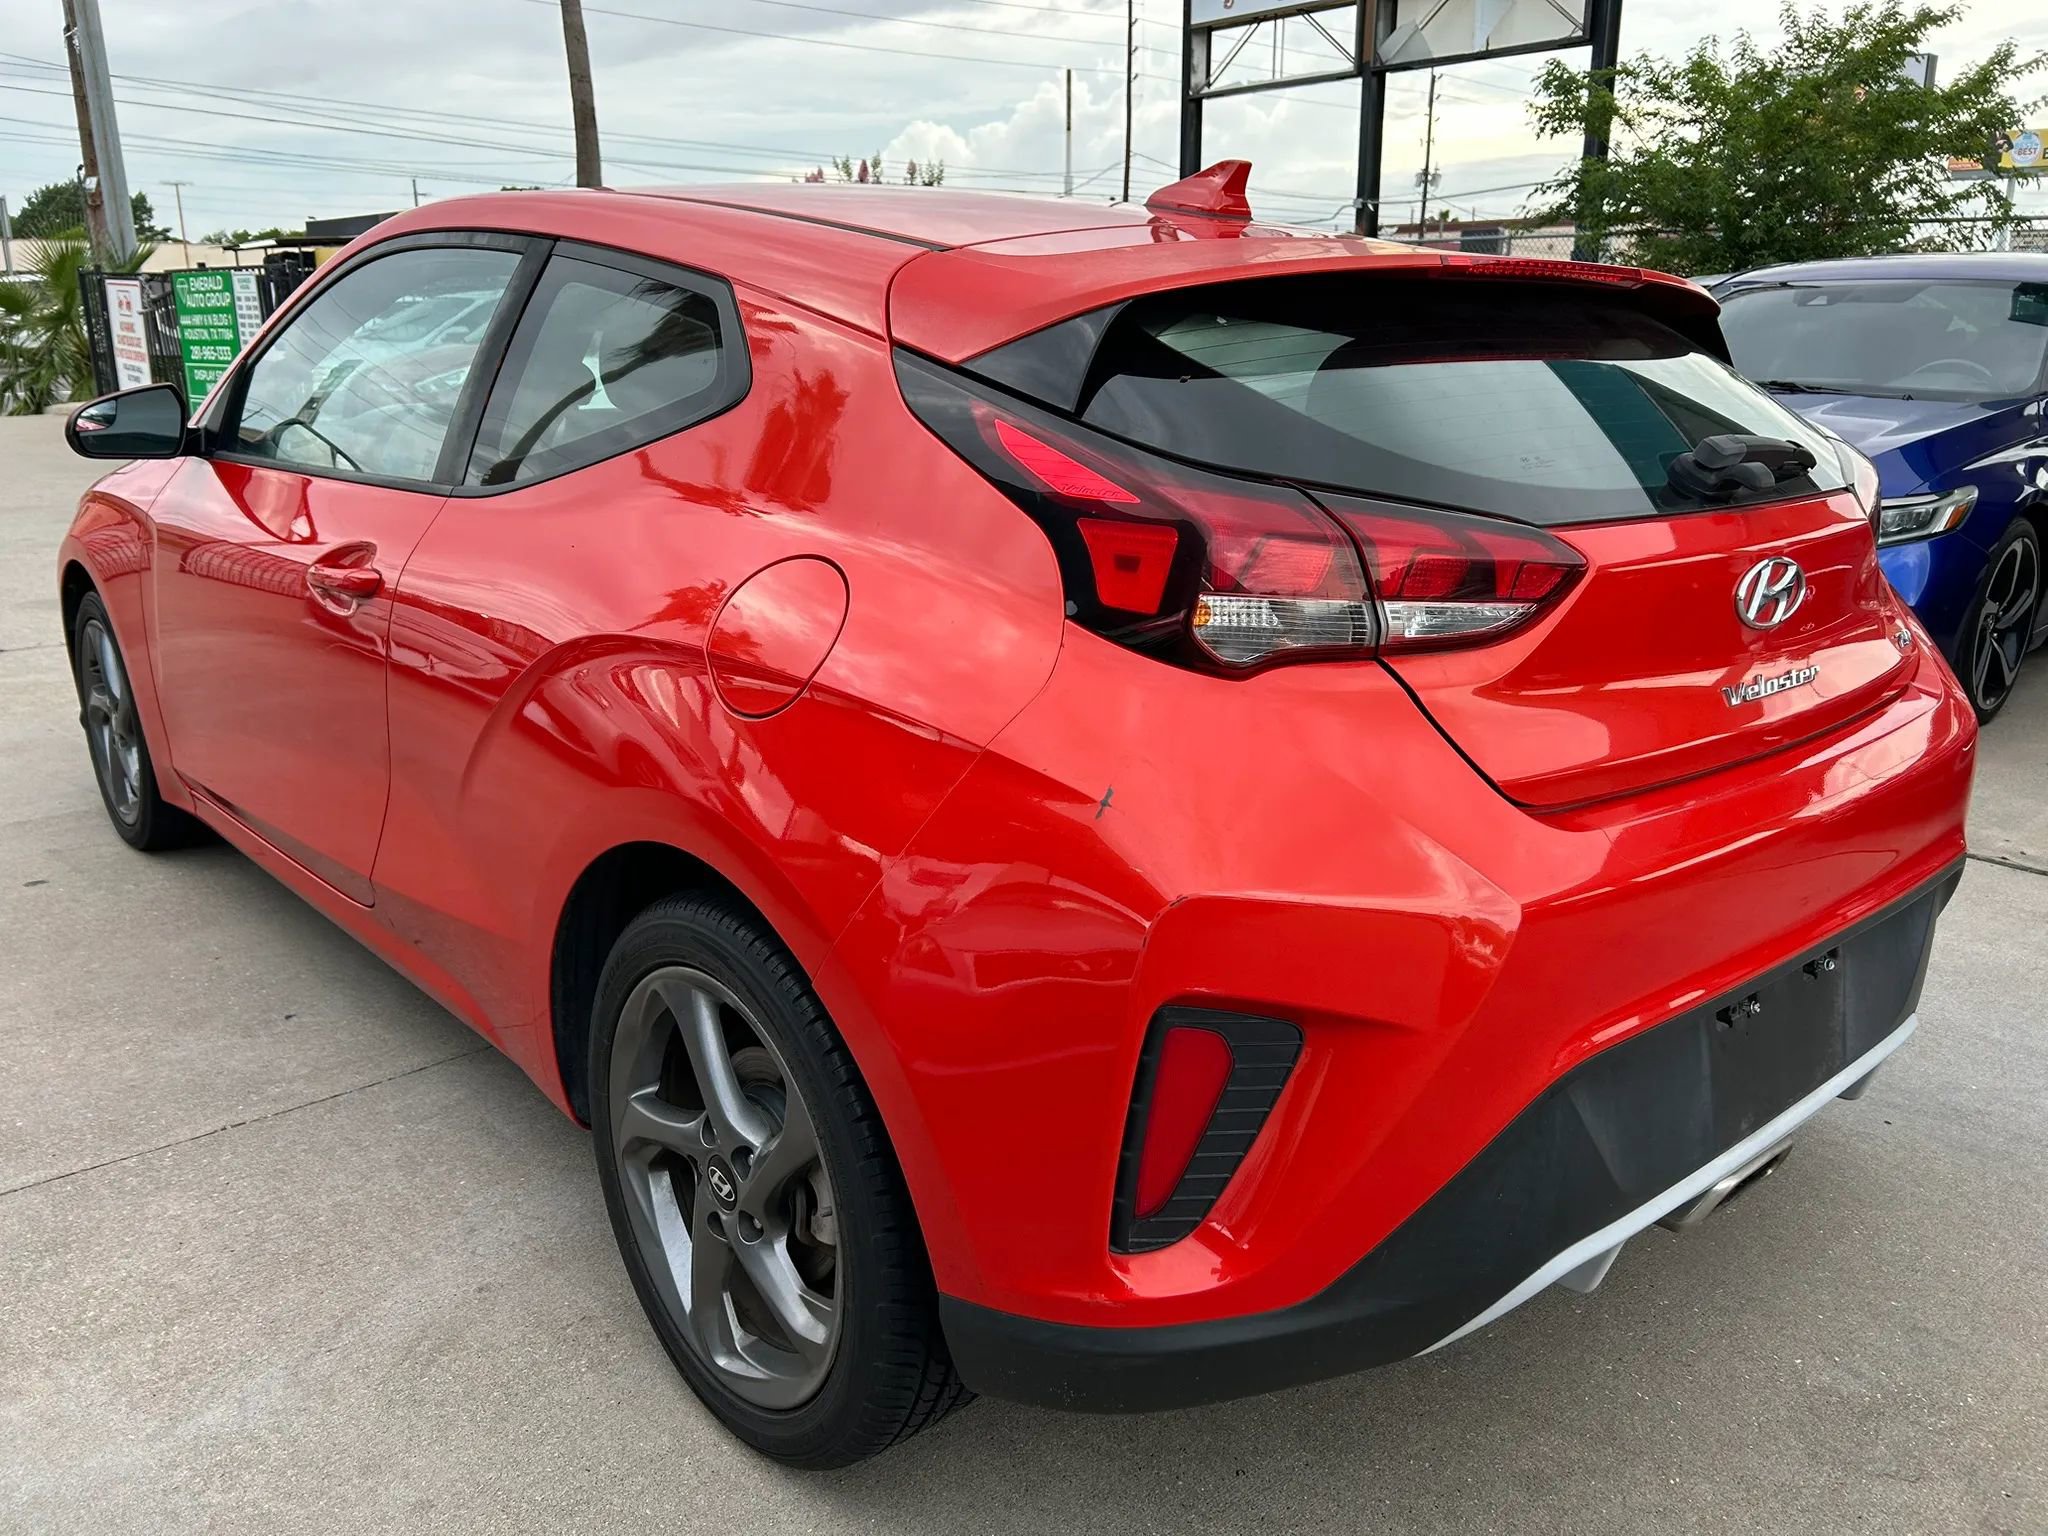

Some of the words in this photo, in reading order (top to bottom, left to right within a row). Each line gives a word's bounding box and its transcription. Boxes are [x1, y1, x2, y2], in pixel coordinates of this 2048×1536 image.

[189, 275, 223, 291] EMERALD
[186, 293, 204, 308] AUTO
[205, 291, 231, 307] GROUP
[1721, 665, 1821, 707] Veloster
